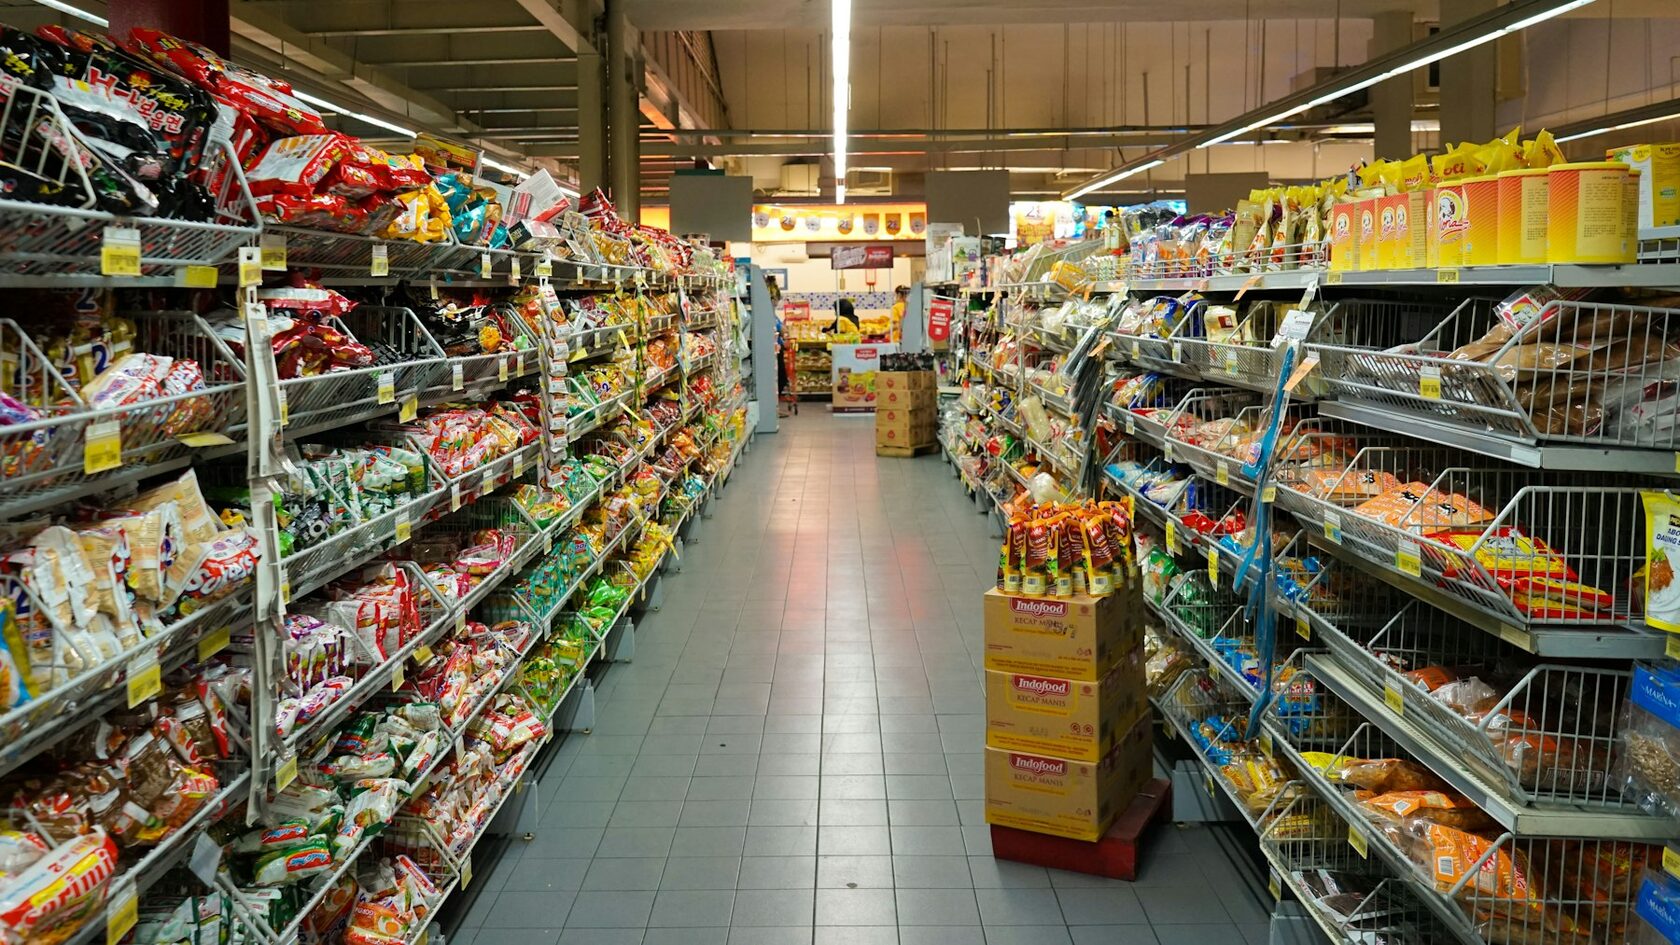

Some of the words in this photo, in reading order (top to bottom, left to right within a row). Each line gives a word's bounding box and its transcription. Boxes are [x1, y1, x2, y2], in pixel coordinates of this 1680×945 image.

[91, 343, 112, 375] 2
[1016, 600, 1064, 615] Indofood
[1019, 678, 1066, 693] Indofood
[1016, 694, 1040, 704] KECAP
[1041, 698, 1066, 707] MANIS
[1016, 757, 1063, 773] Indofood
[1014, 773, 1037, 783] KECAP
